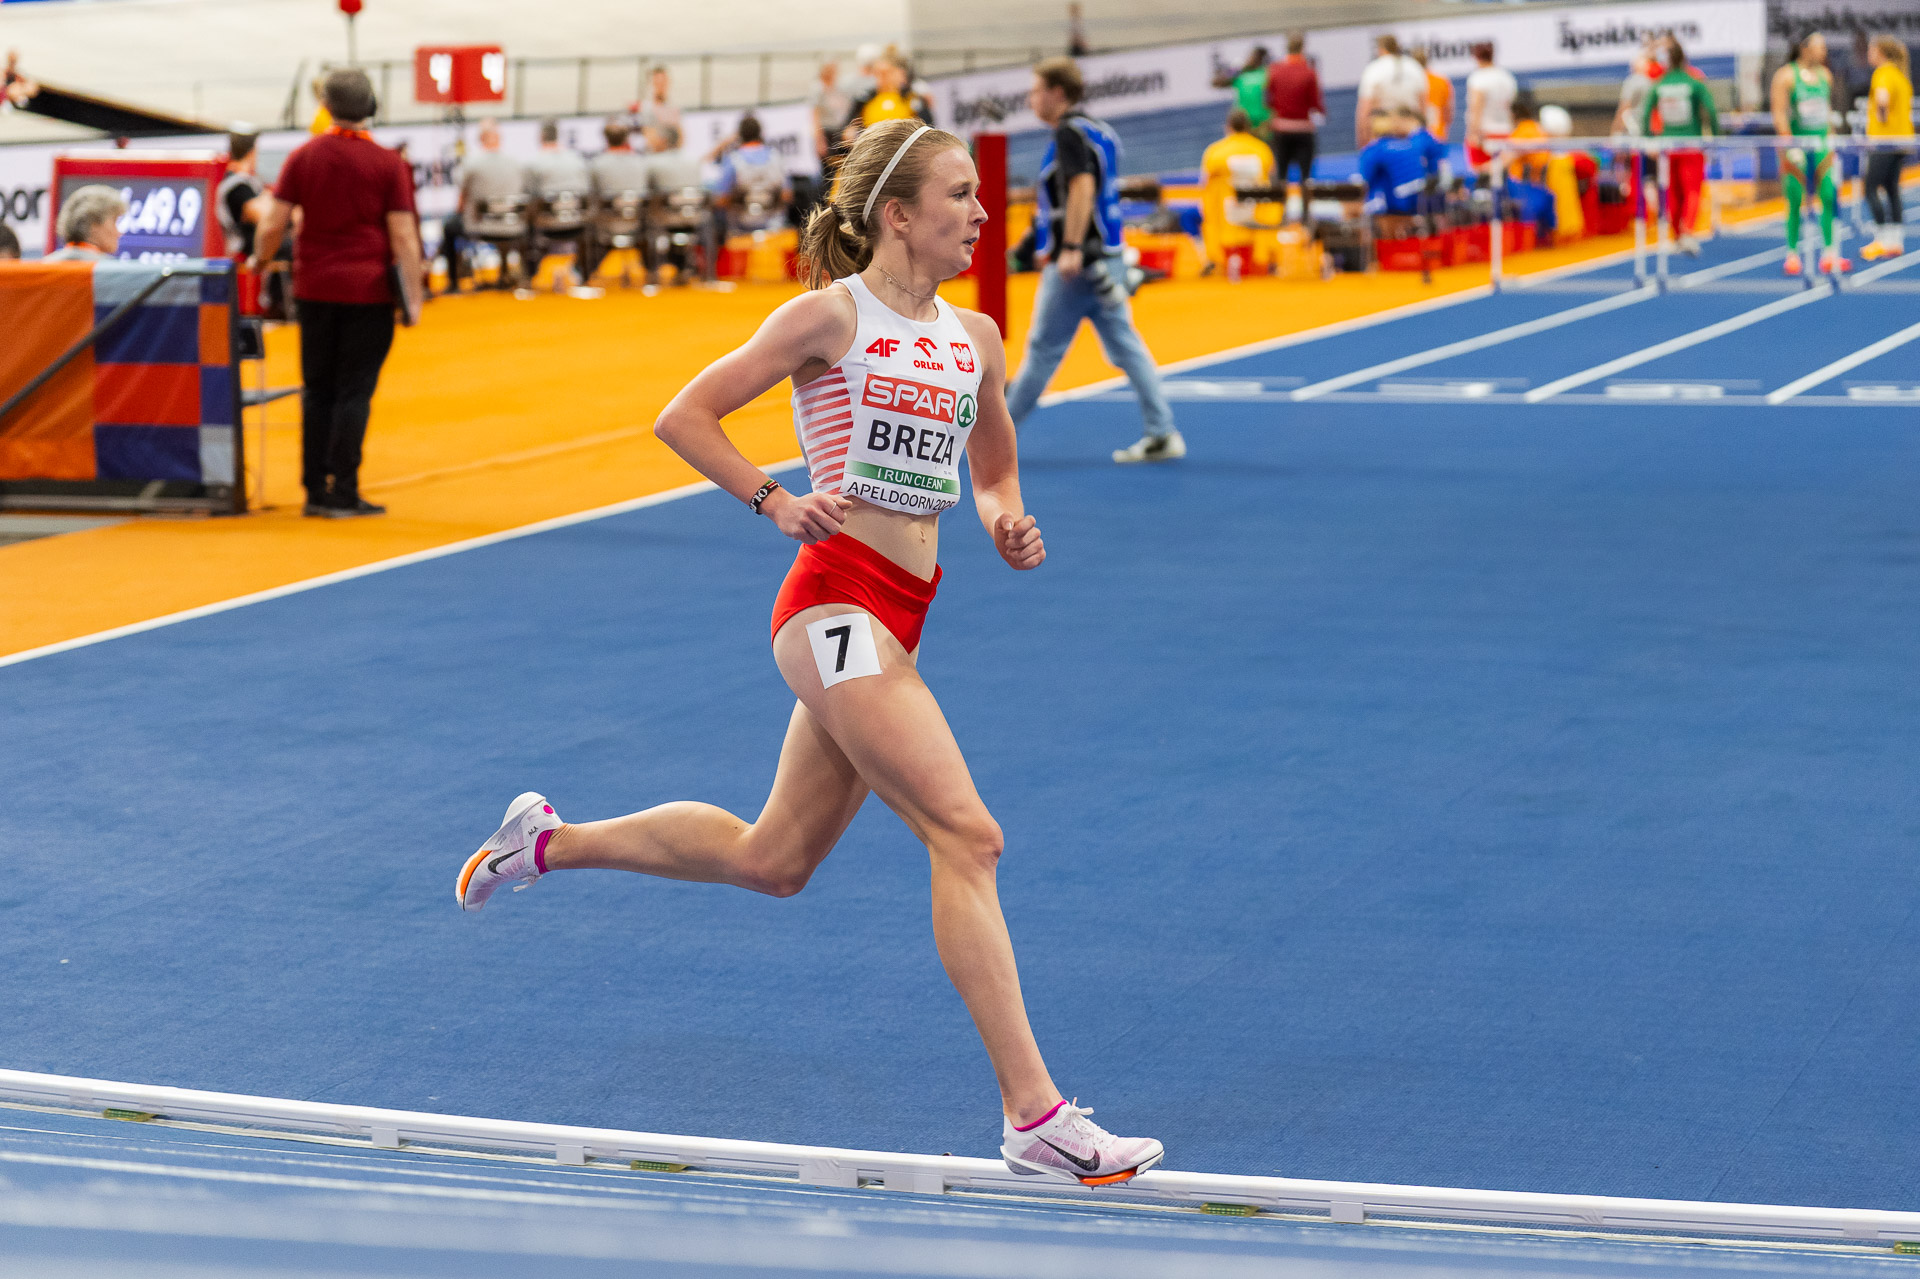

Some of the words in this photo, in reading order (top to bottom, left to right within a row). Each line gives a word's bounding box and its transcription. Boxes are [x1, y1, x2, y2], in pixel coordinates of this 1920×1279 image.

[866, 338, 900, 358] 4F
[913, 360, 944, 371] ORLEN
[866, 379, 955, 419] SPAR
[867, 419, 955, 466] BREZA
[877, 468, 882, 479] I
[884, 469, 914, 485] RUN
[847, 481, 934, 510] APELDOORN
[825, 625, 851, 673] 7
